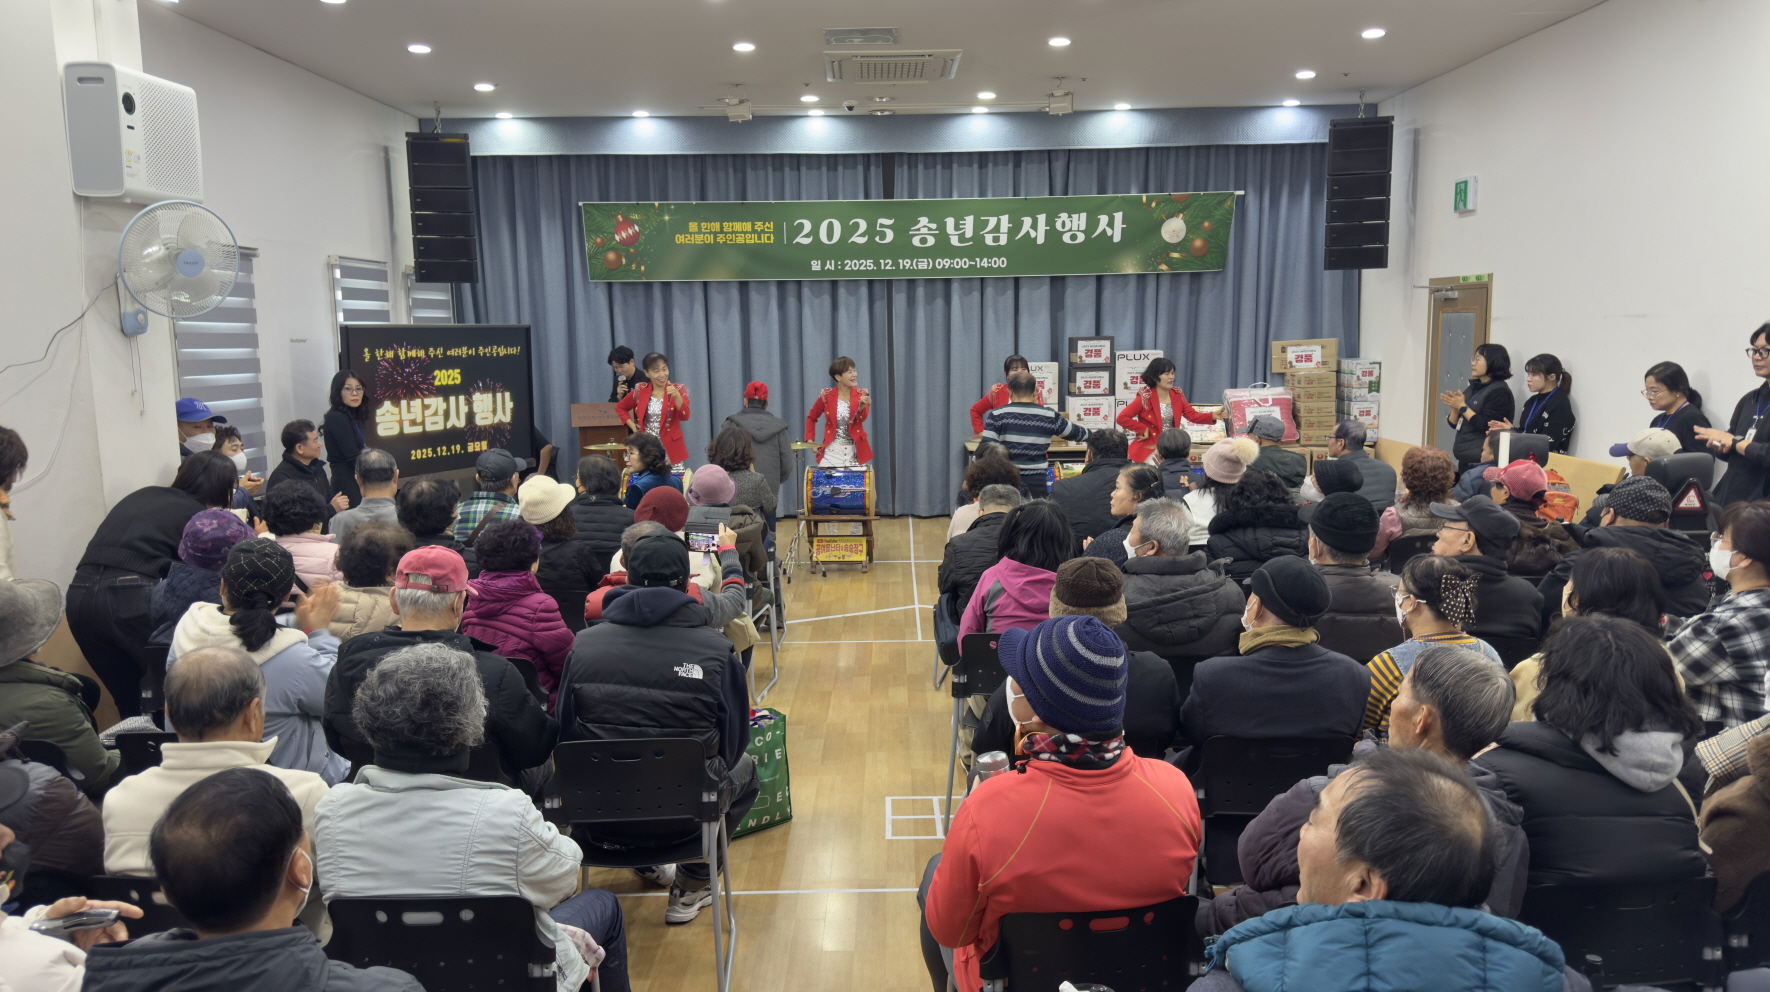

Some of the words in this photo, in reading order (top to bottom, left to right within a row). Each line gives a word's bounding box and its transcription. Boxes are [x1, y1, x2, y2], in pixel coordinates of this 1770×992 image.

[688, 222, 699, 232] 올
[700, 222, 721, 232] 한해
[722, 222, 752, 232] 함께해
[754, 221, 774, 232] 주신
[792, 218, 895, 245] 2025
[908, 211, 1127, 248] 송년감사행사
[675, 234, 714, 244] 여러분이
[716, 233, 775, 244] 주인공입니다
[810, 260, 822, 271] 일
[844, 259, 877, 271] 2025.
[879, 259, 896, 270] 12.
[899, 258, 933, 271] 19.(금)
[935, 257, 1008, 269] 09:00~14:00
[363, 348, 371, 362] 올
[374, 348, 395, 361] 한해
[397, 347, 426, 361] 함께해
[428, 346, 444, 358] 주신
[446, 346, 476, 358] 여러분이
[477, 345, 521, 357] 주인공입니다!
[1085, 348, 1102, 358] 경품
[1117, 353, 1150, 361] PLUX
[1295, 354, 1313, 363] 경품
[433, 369, 461, 386] 2025
[1083, 380, 1101, 389] 경품
[375, 395, 469, 437] 송년감사
[472, 391, 514, 426] 행사
[1083, 407, 1101, 417] 경품
[410, 444, 464, 460] 2025.12.19.
[467, 441, 488, 453] 금요일
[678, 670, 694, 678] FACE
